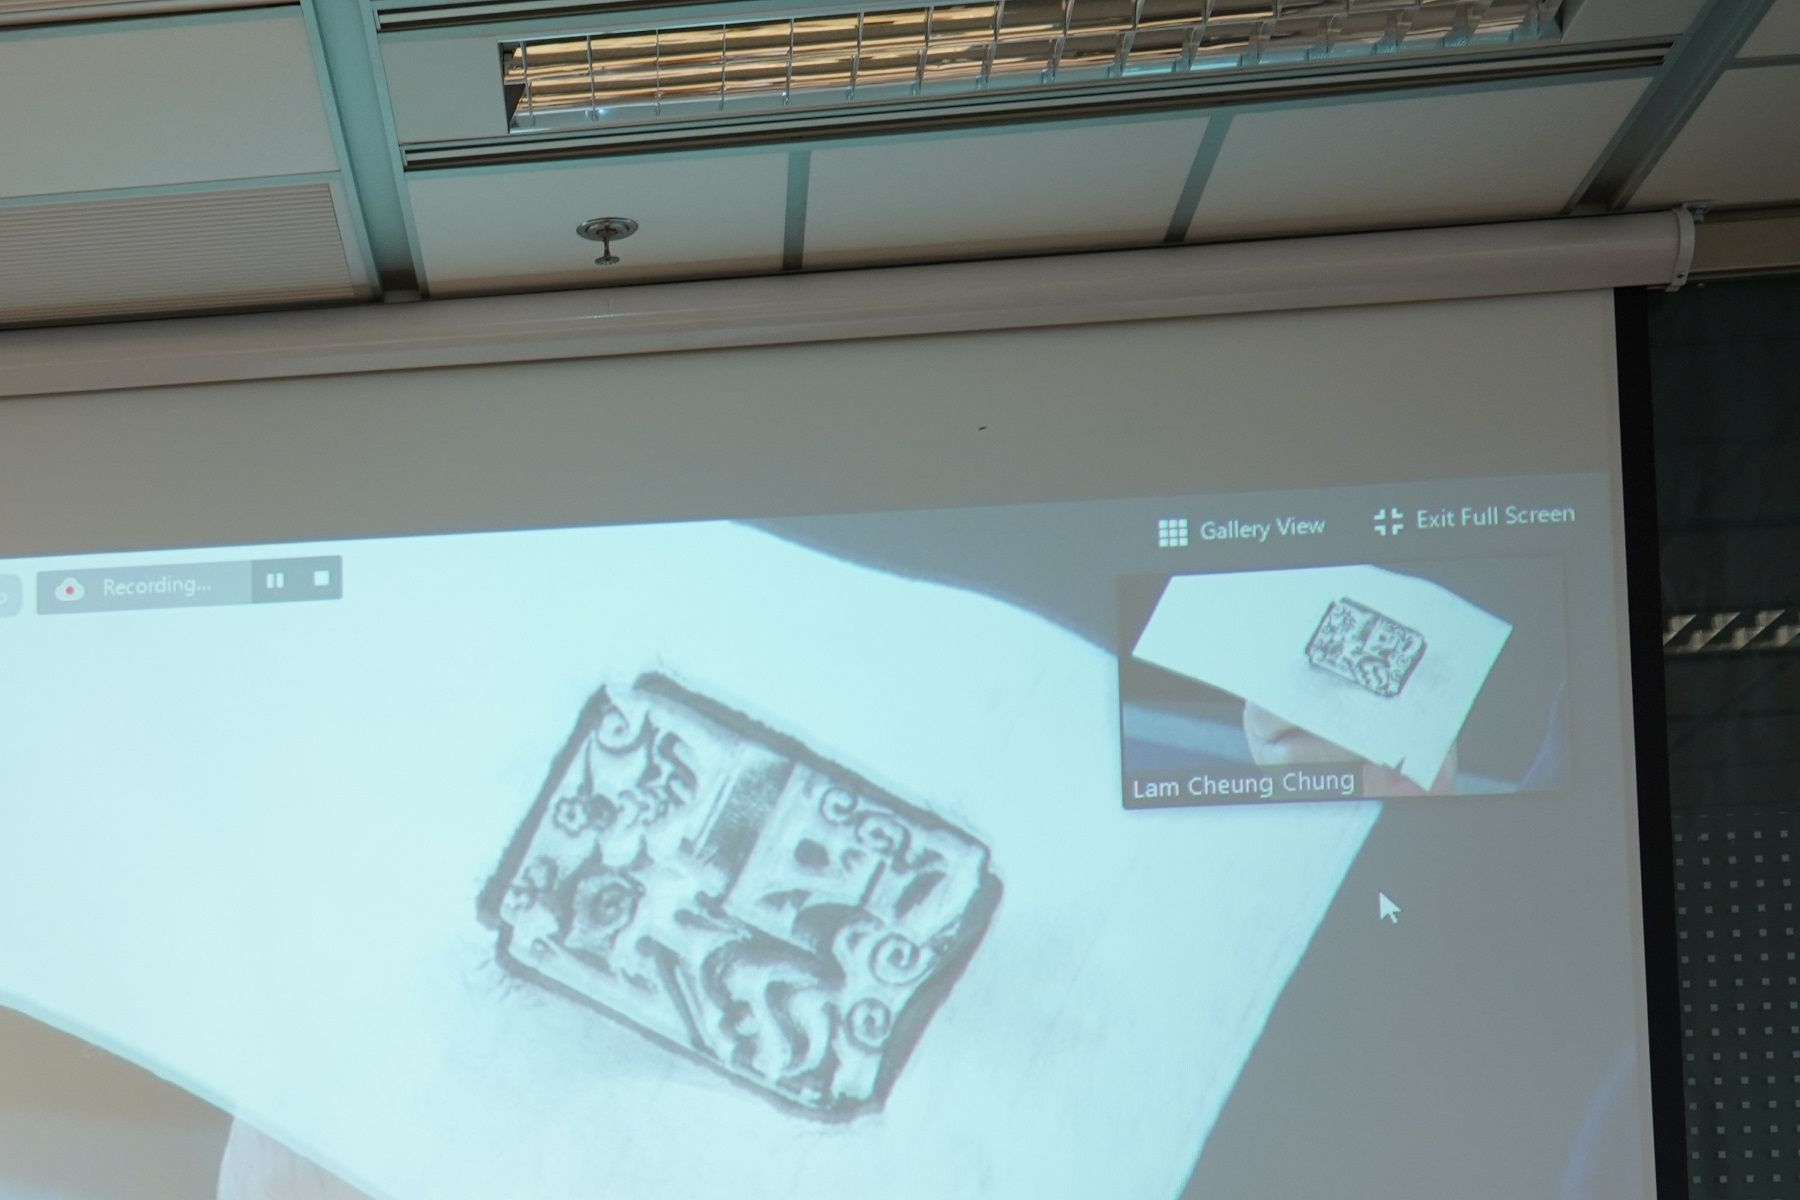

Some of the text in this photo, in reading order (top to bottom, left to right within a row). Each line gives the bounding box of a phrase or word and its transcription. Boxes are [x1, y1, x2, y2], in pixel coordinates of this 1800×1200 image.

[1200, 515, 1326, 543] Gallery View
[1417, 503, 1576, 529] Exit Full Screen
[1133, 770, 1356, 799] Lam Cheung Chung
